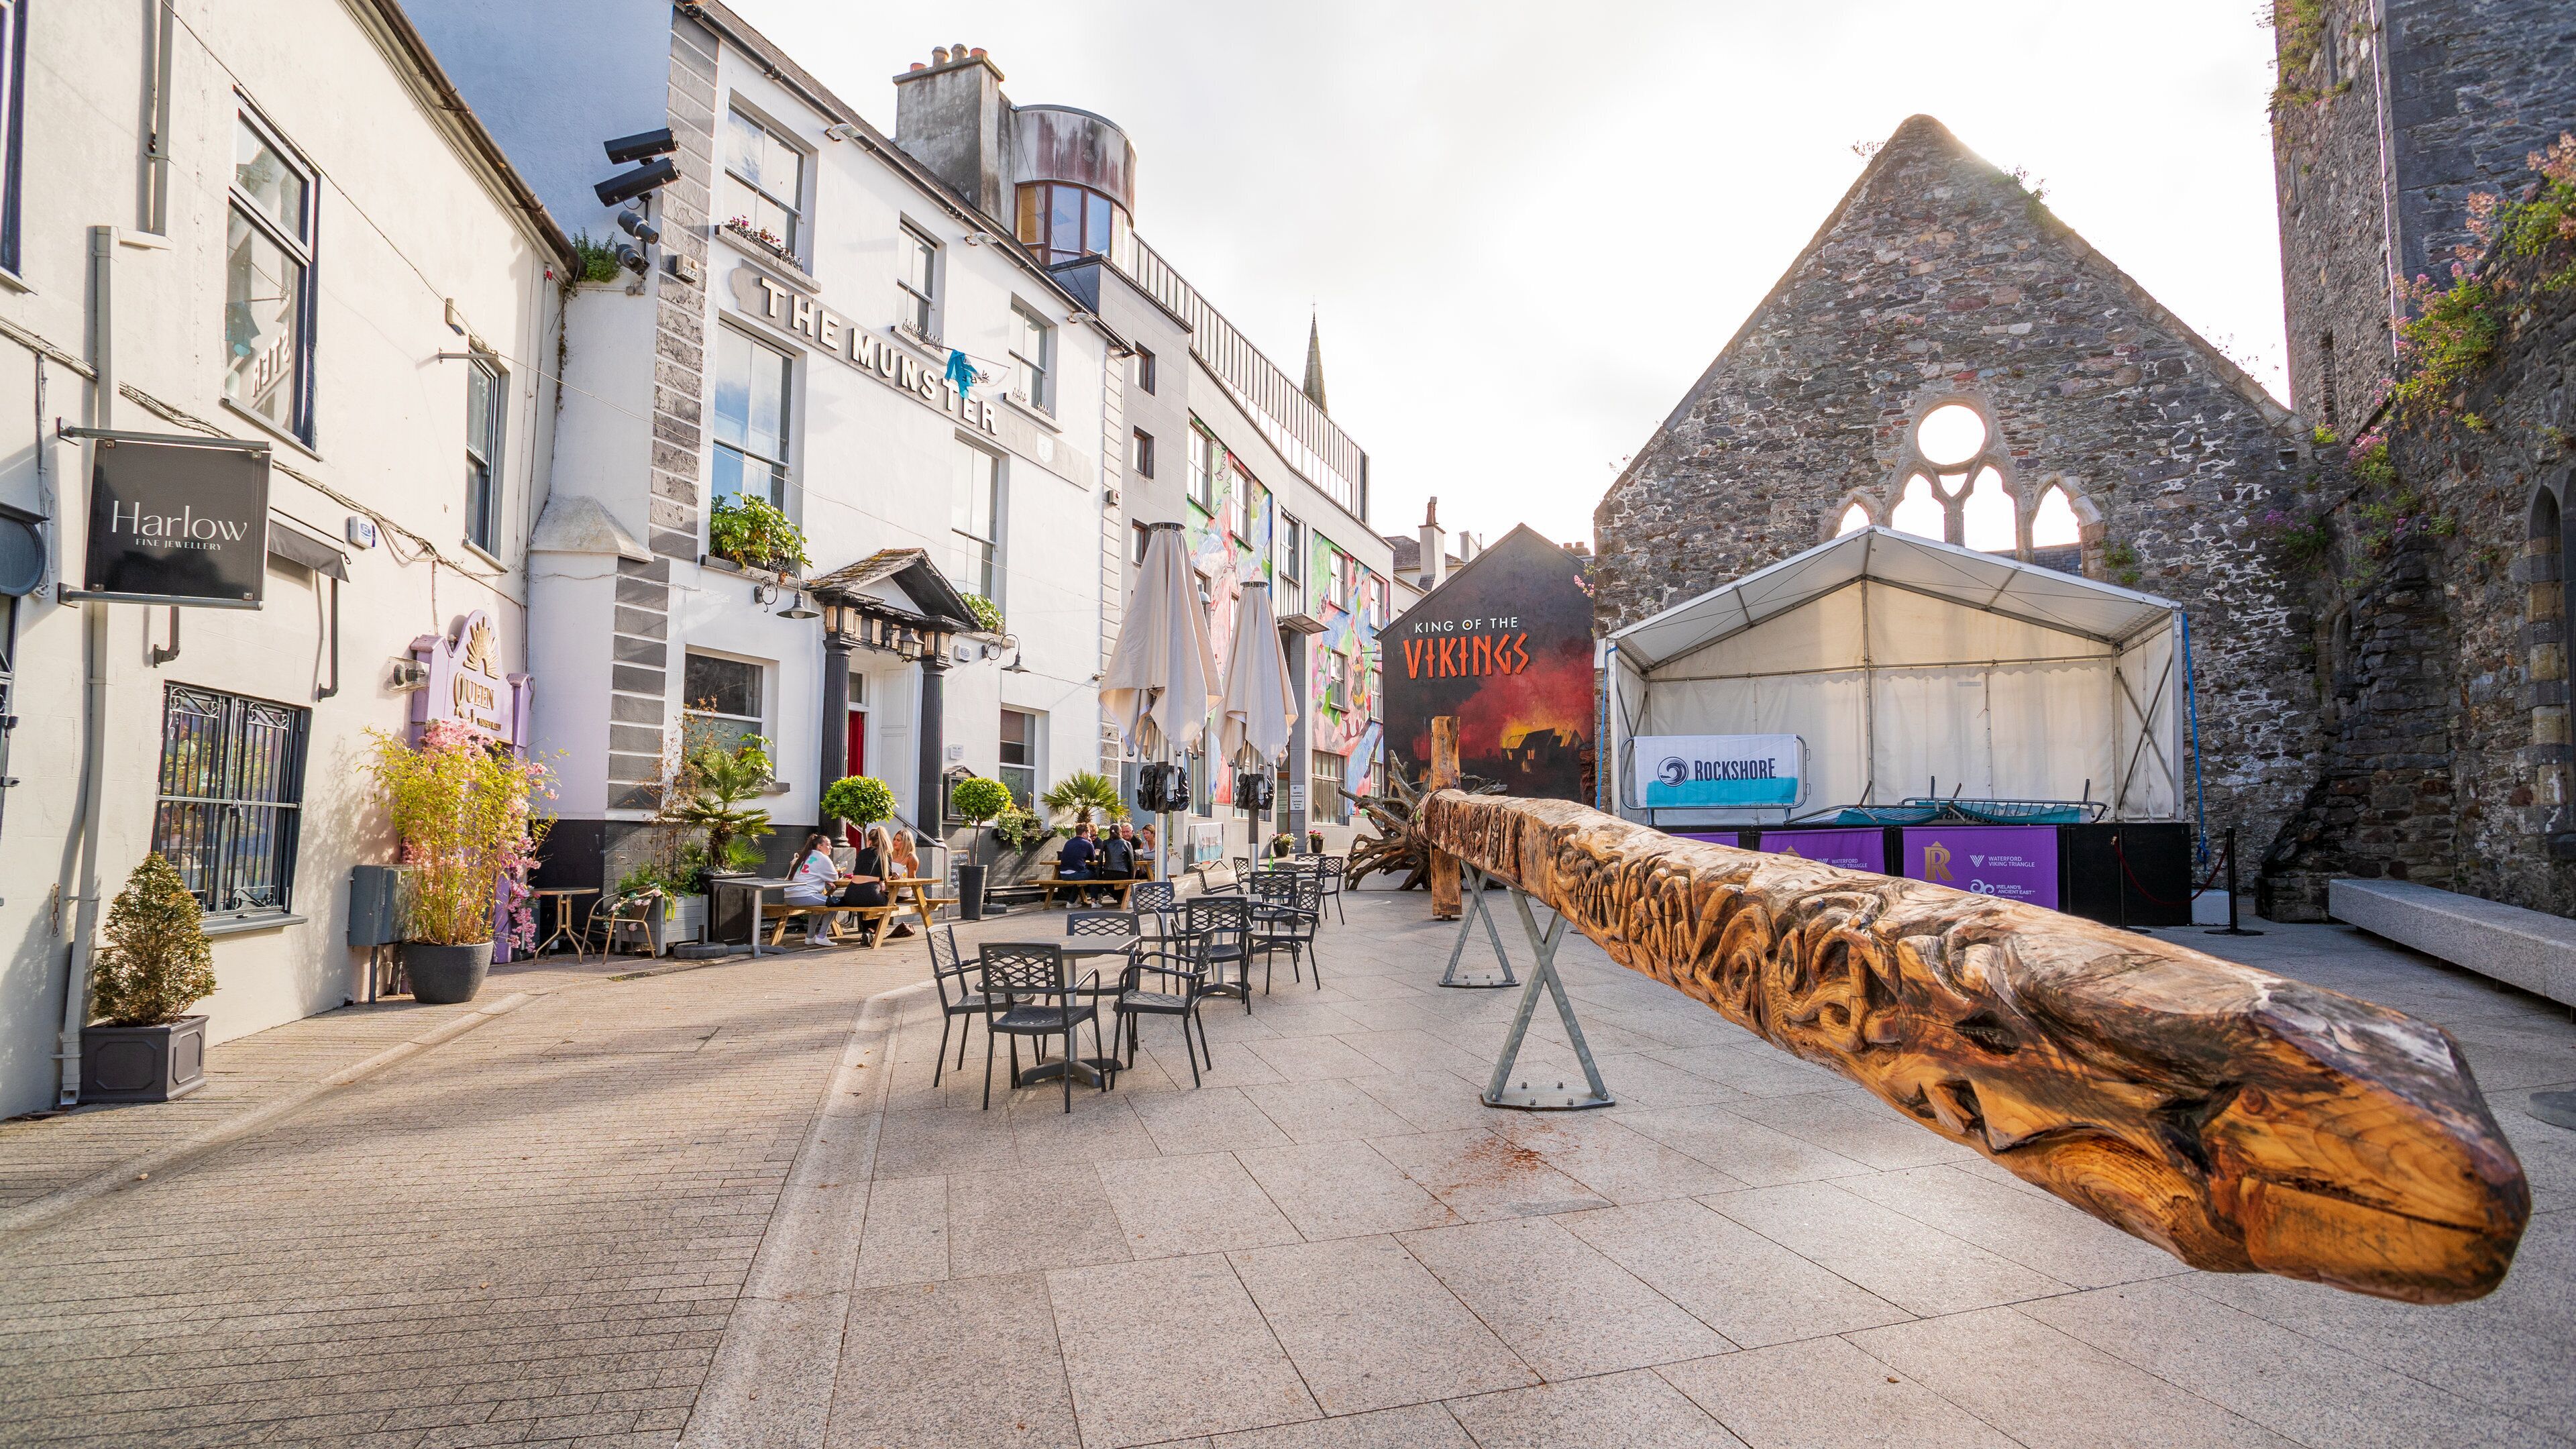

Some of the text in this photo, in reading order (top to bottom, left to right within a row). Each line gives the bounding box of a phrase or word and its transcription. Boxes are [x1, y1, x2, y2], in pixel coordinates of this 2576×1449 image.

[761, 276, 998, 436] THE MUNSTER
[112, 500, 248, 541] Harlow
[136, 538, 222, 551] FINE JEWELLERY
[1415, 616, 1518, 633] KING OF THE
[1403, 633, 1529, 680] VIKINGS
[453, 672, 494, 718] QUEEN
[1694, 758, 1776, 782] ROCKSHORE
